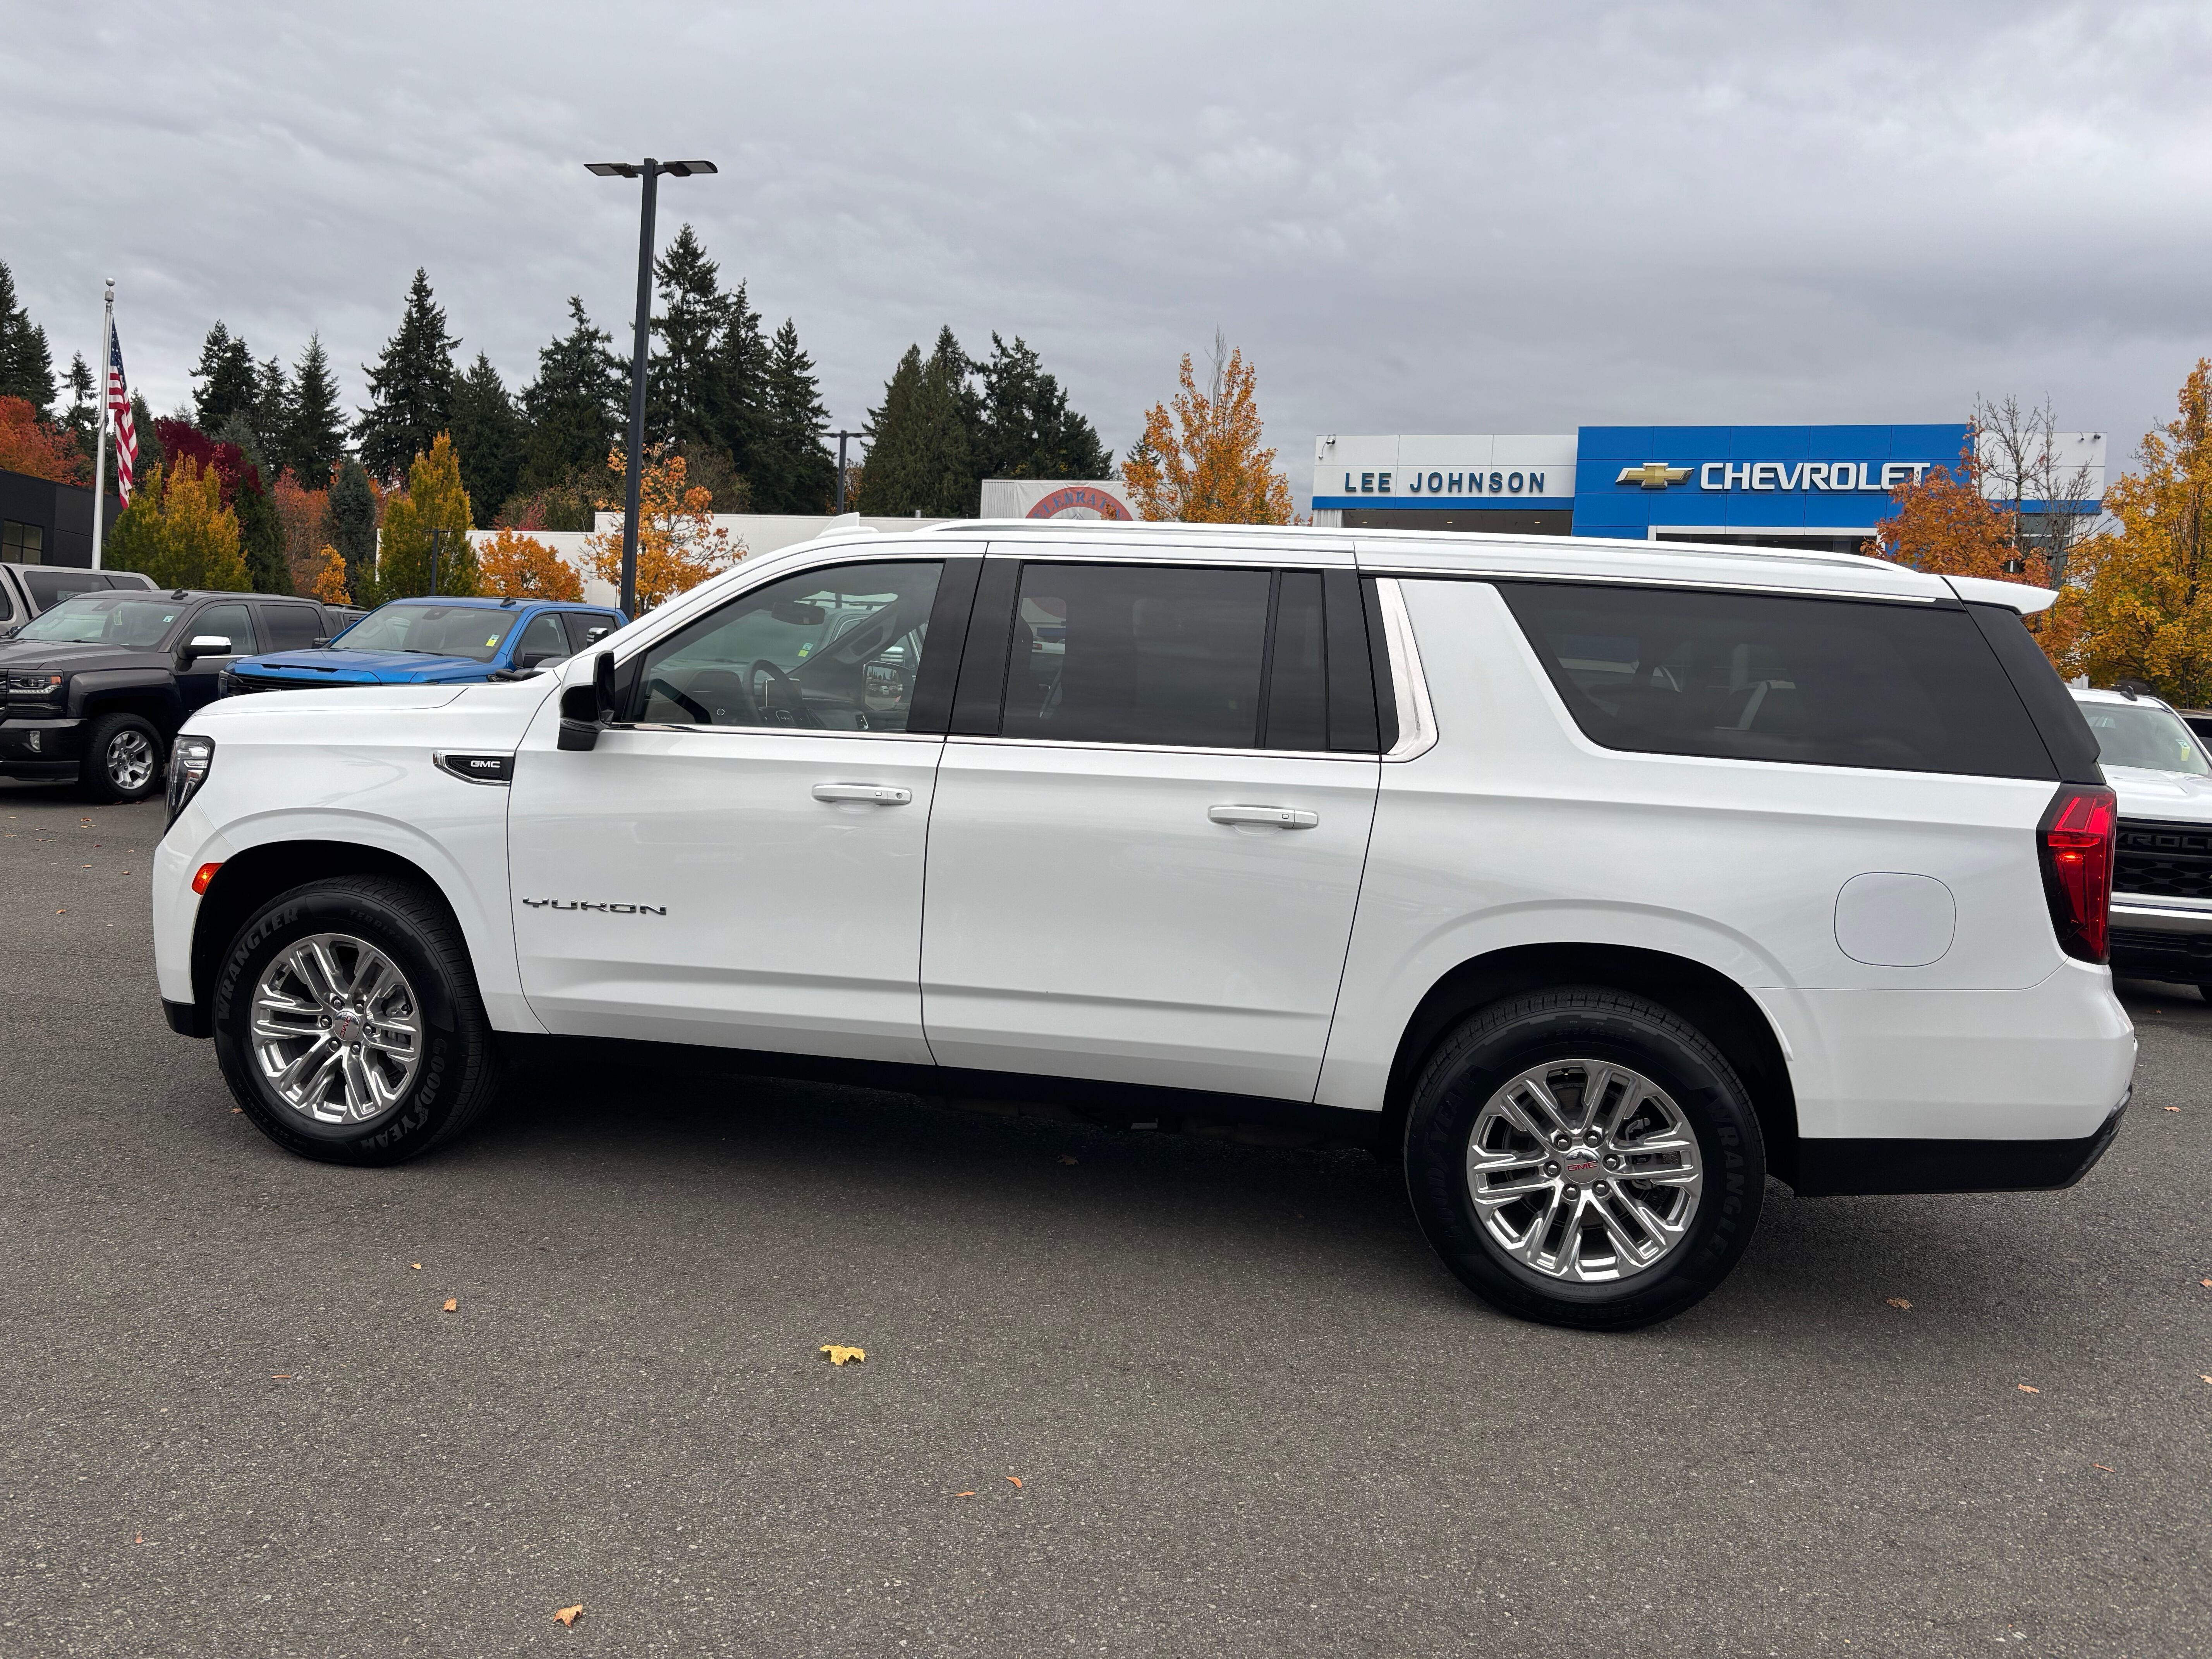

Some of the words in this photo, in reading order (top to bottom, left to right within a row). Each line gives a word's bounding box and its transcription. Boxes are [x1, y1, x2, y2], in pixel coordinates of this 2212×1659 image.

[1345, 472, 1392, 492] LEE
[1409, 472, 1545, 493] JOHNSON
[1700, 462, 1931, 490] CHEVROLET
[470, 760, 501, 768] GMC
[522, 896, 667, 916] YUKON
[218, 907, 299, 1020] WRANGLER
[339, 1015, 352, 1038] GMC
[360, 1037, 448, 1154] GOODYEAR
[1567, 1160, 1598, 1171] GMC
